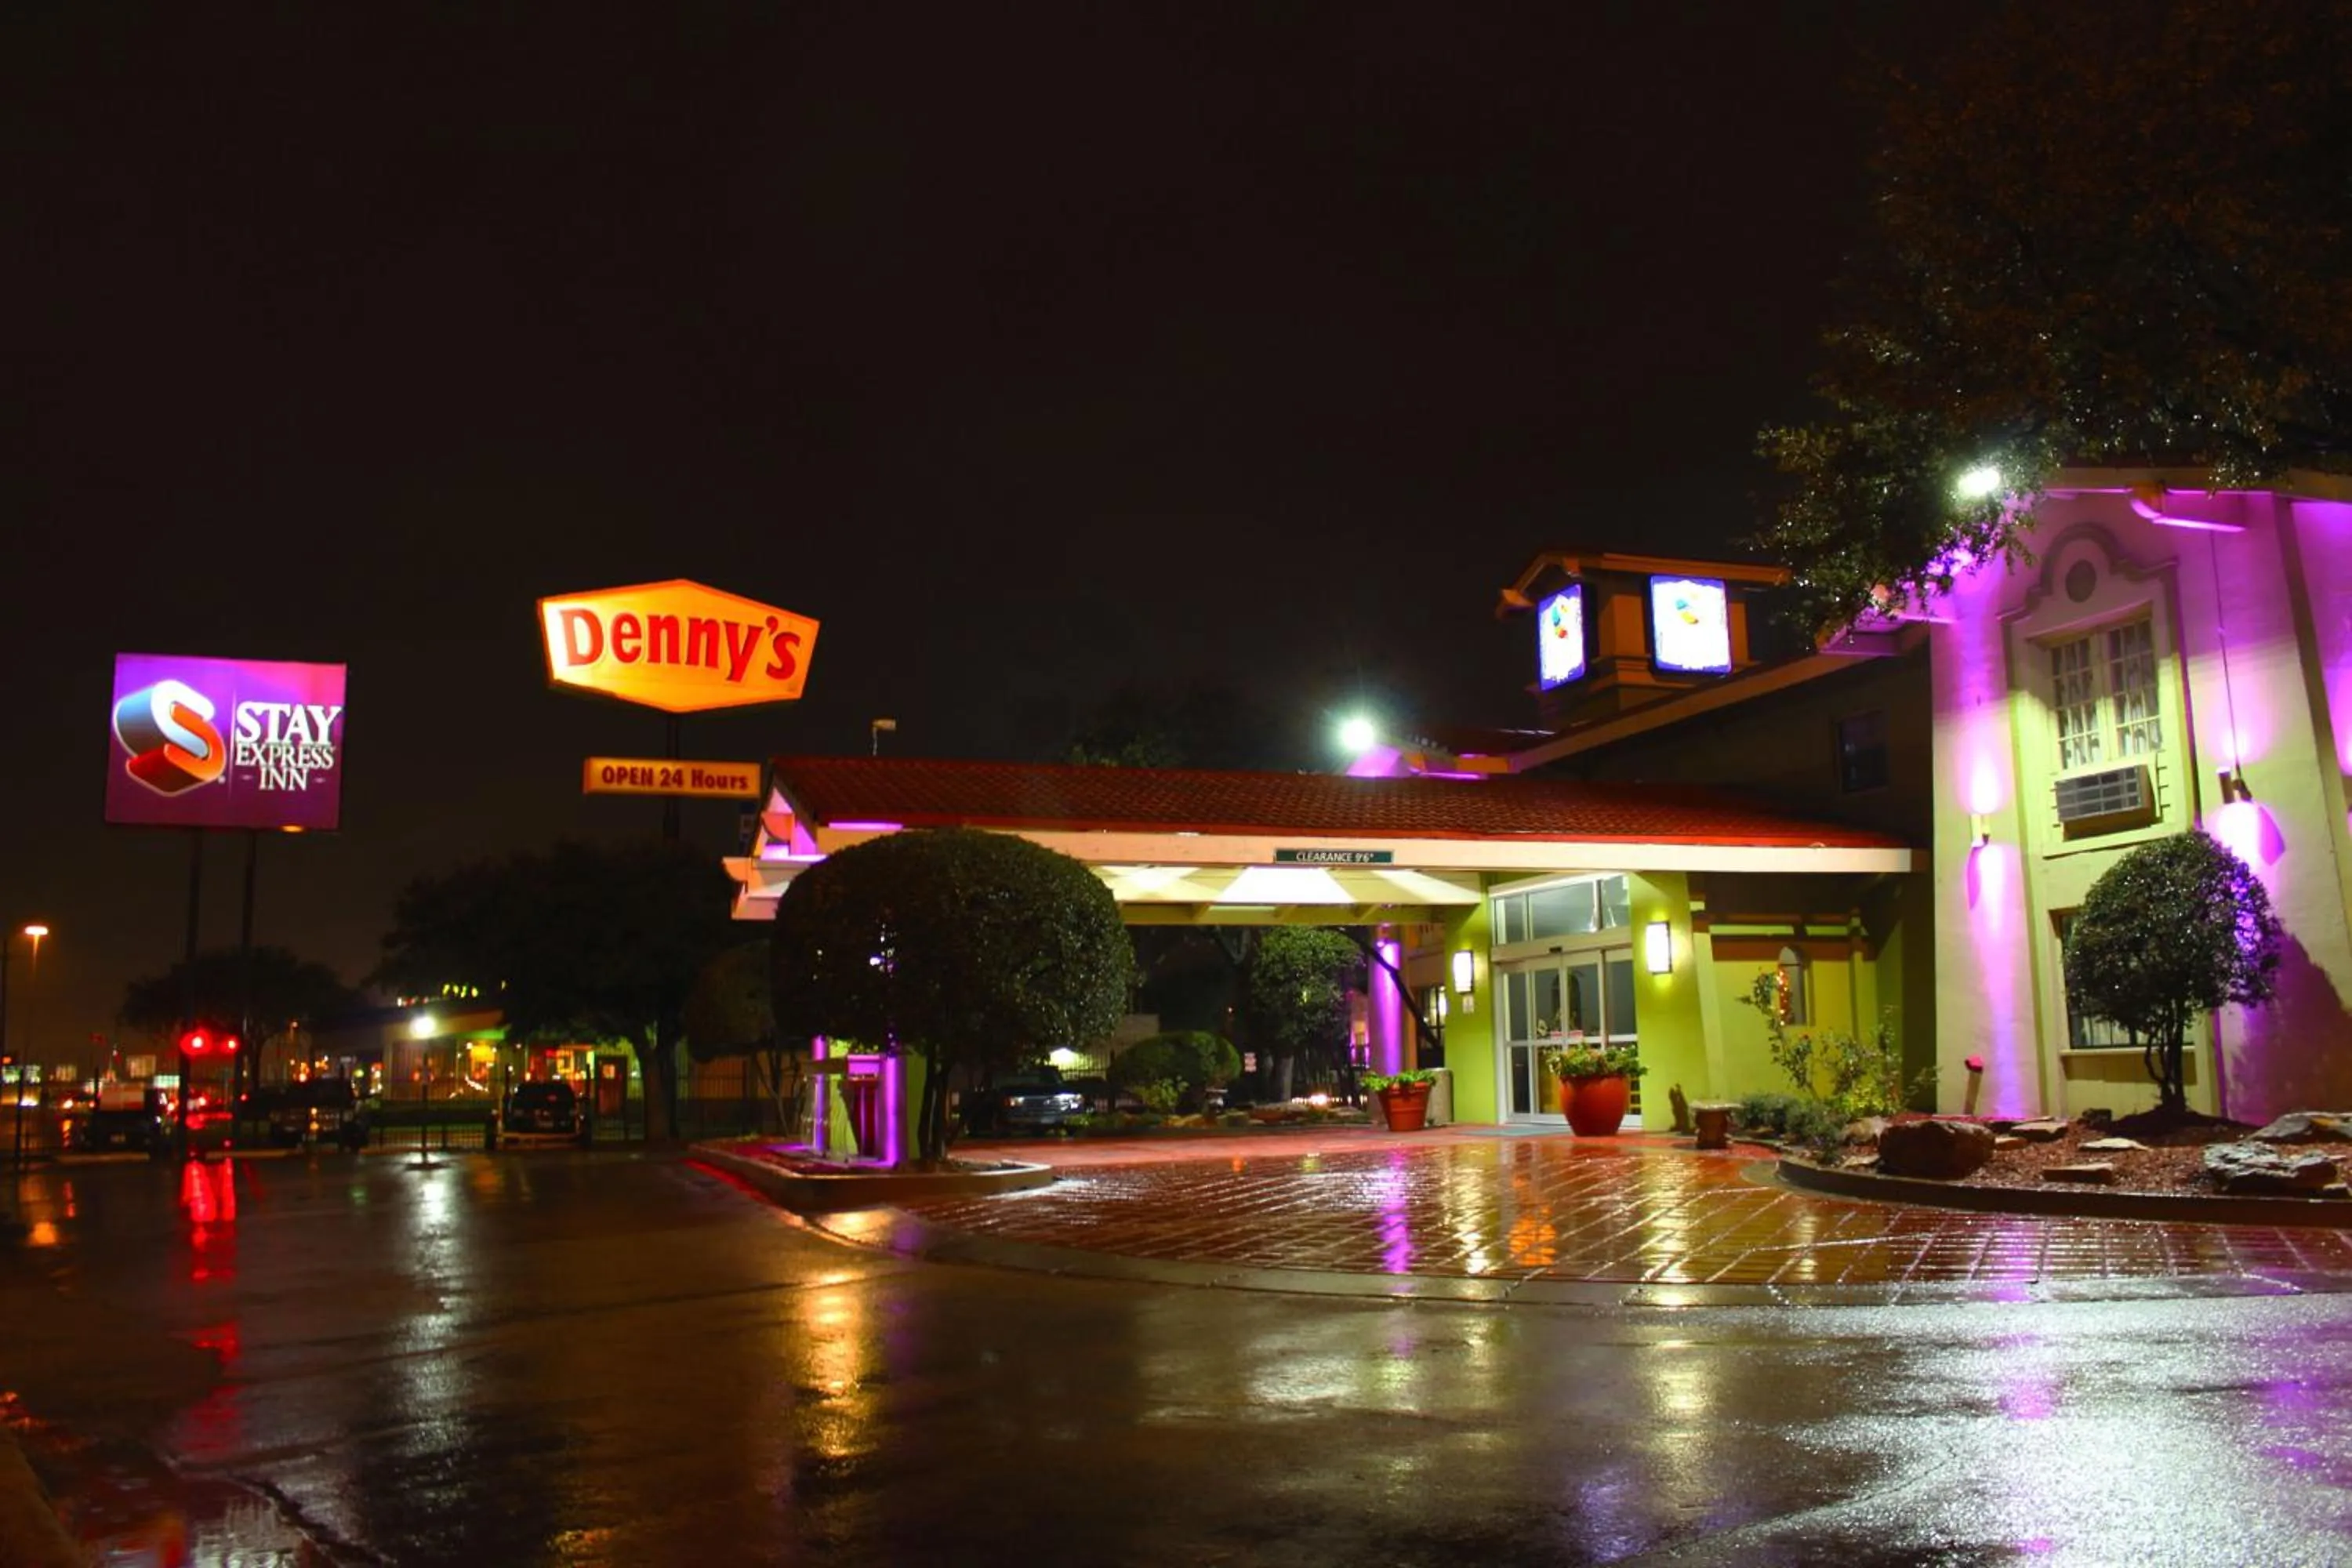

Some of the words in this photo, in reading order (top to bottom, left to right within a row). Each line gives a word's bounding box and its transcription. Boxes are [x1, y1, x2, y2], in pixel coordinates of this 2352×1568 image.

[559, 608, 800, 682] Denny's
[235, 702, 342, 744] STAY
[235, 743, 334, 769] EXPRESS
[259, 768, 308, 790] INN
[601, 766, 654, 786] OPEN
[660, 768, 683, 788] 24
[691, 769, 749, 790] Hours
[1296, 851, 1352, 862] CLEARANCE
